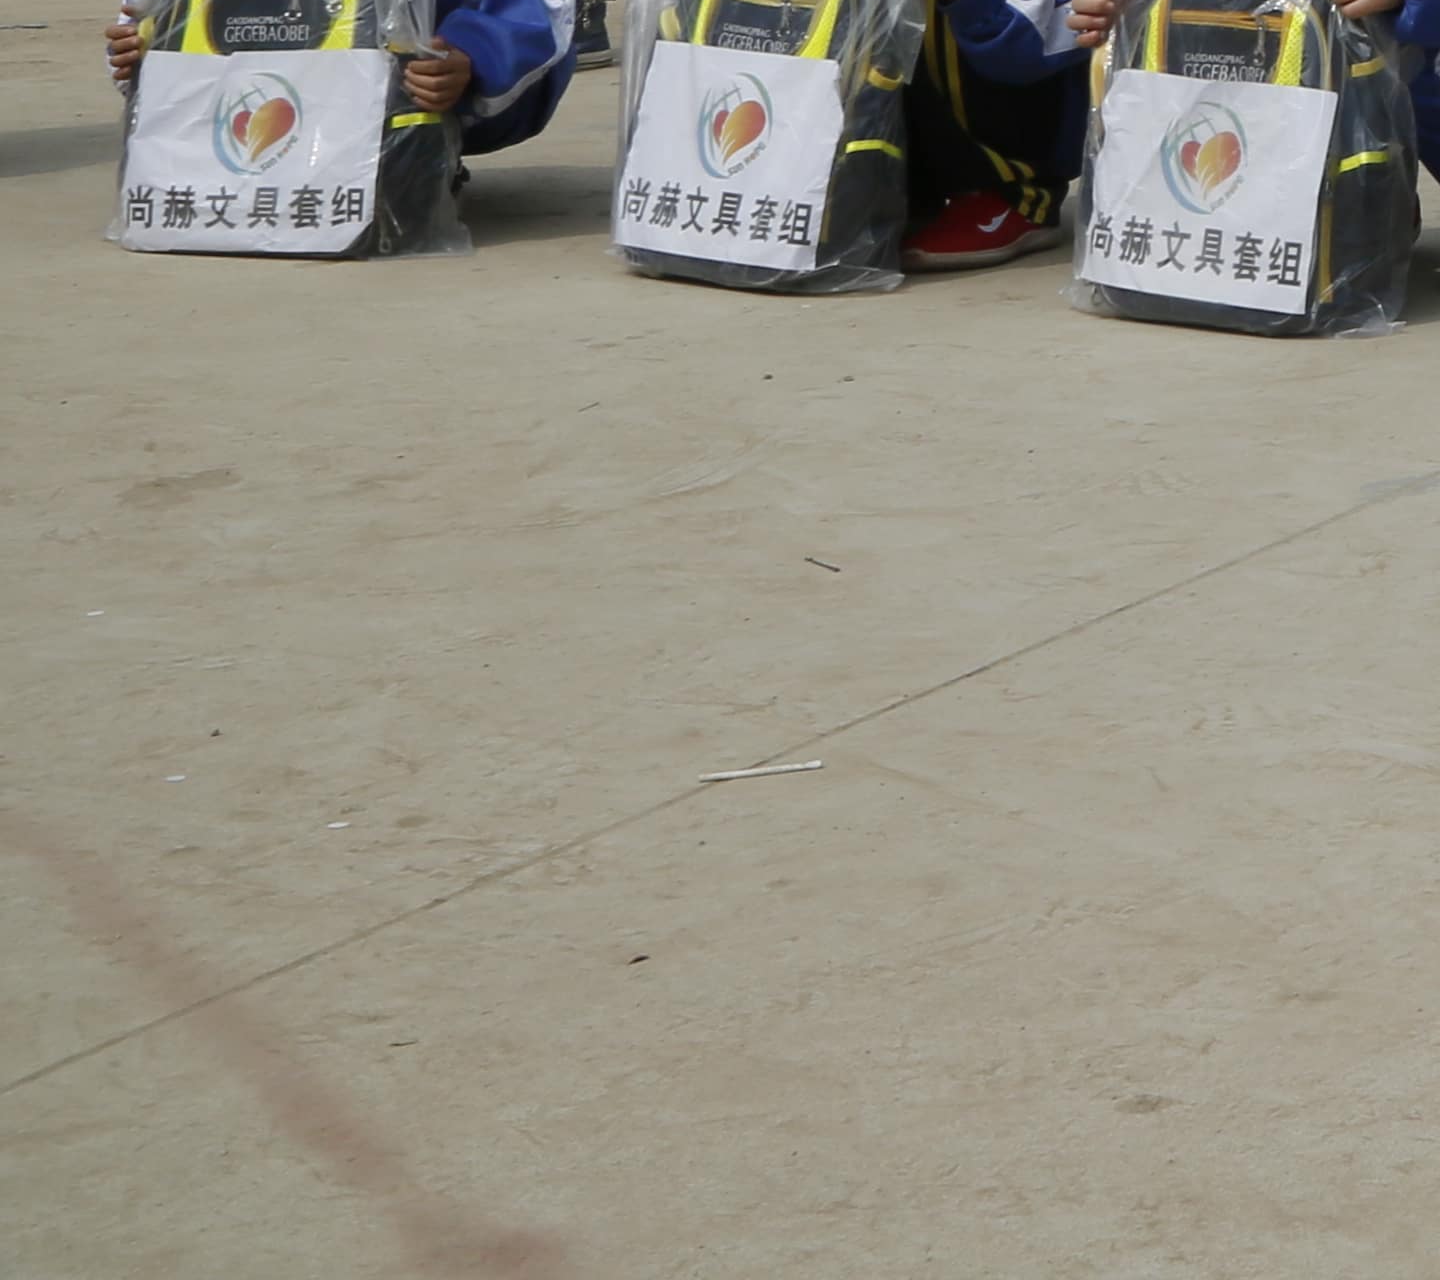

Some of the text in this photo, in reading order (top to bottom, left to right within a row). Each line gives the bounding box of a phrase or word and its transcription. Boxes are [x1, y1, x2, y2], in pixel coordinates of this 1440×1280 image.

[126, 184, 365, 229] 尚赫文具套组
[621, 176, 814, 247] 尚赫文具套组
[1088, 211, 1303, 288] 尚赫文具套组
